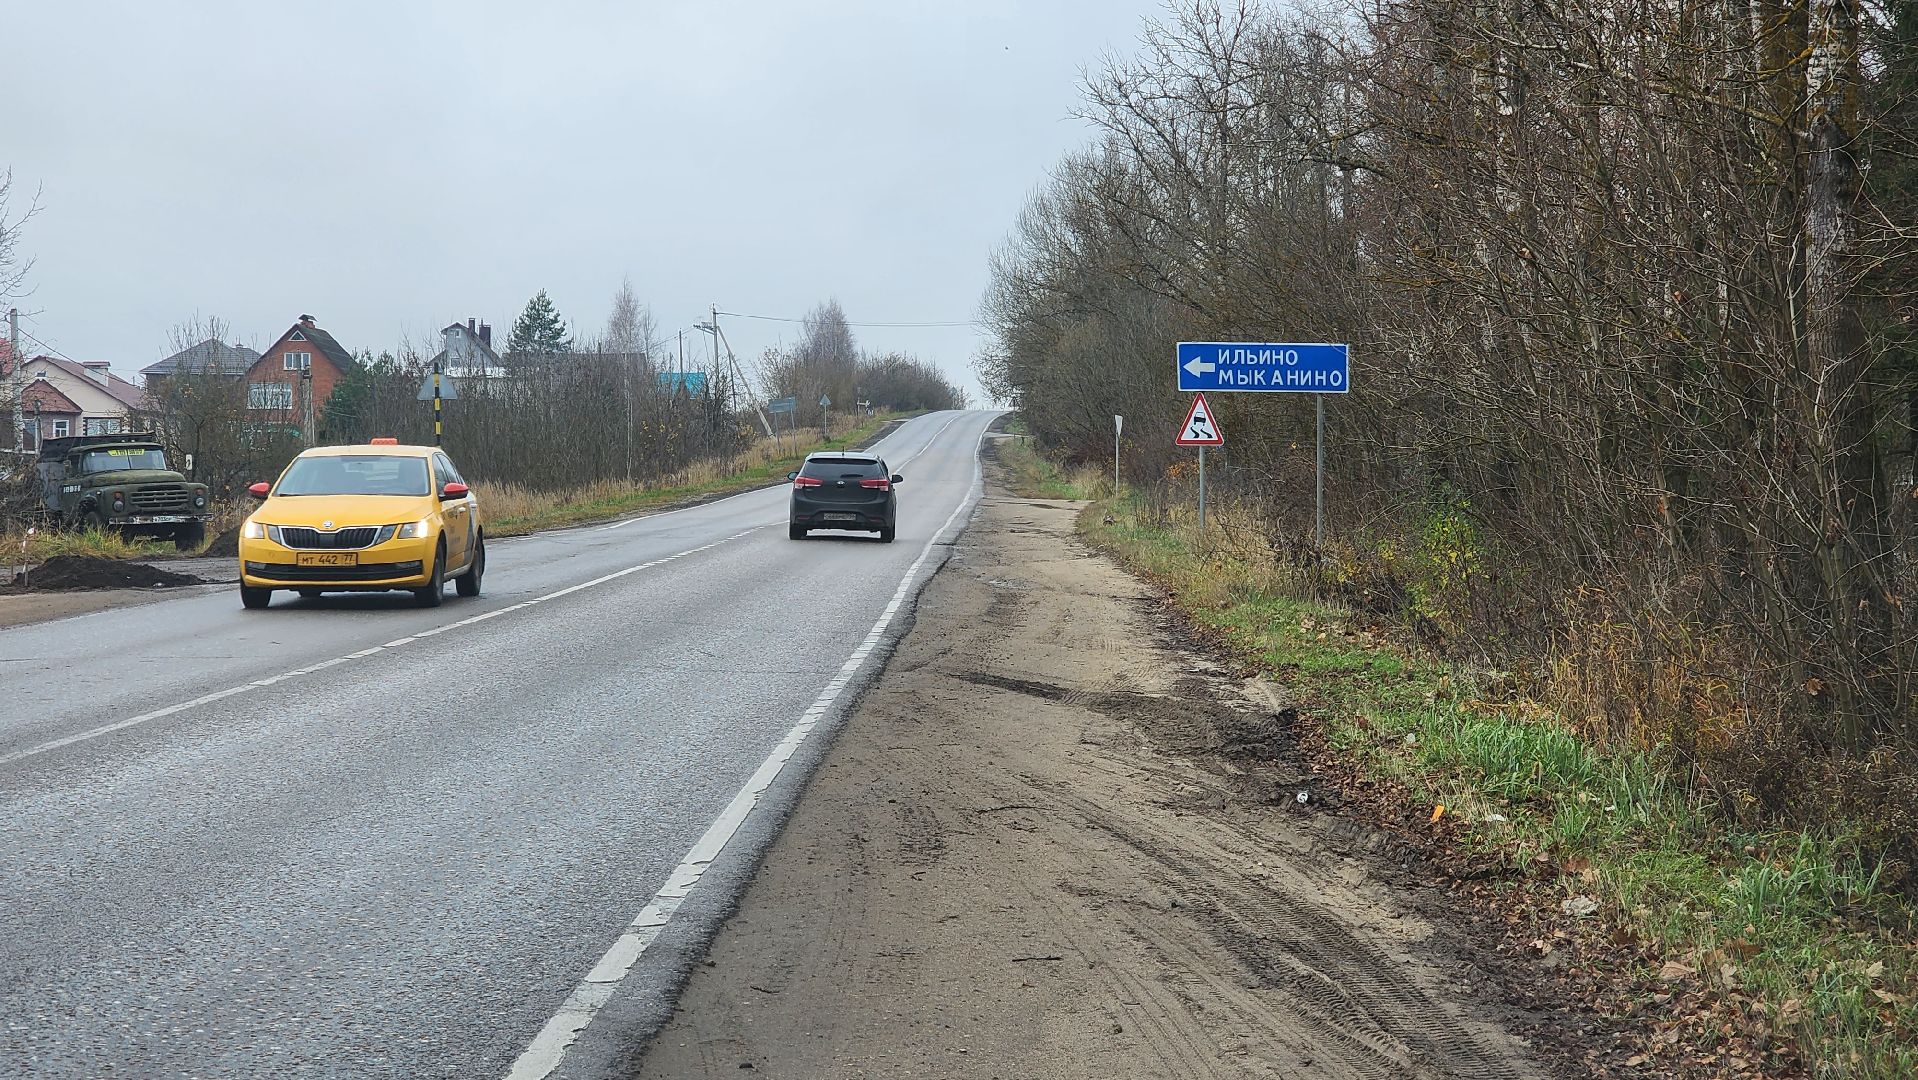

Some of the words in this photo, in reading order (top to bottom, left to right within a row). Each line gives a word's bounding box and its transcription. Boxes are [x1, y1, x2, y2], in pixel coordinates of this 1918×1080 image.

[1218, 348, 1299, 366] ИЛЬИНО
[1218, 369, 1343, 387] МЫКАНИНО
[319, 554, 338, 565] 442
